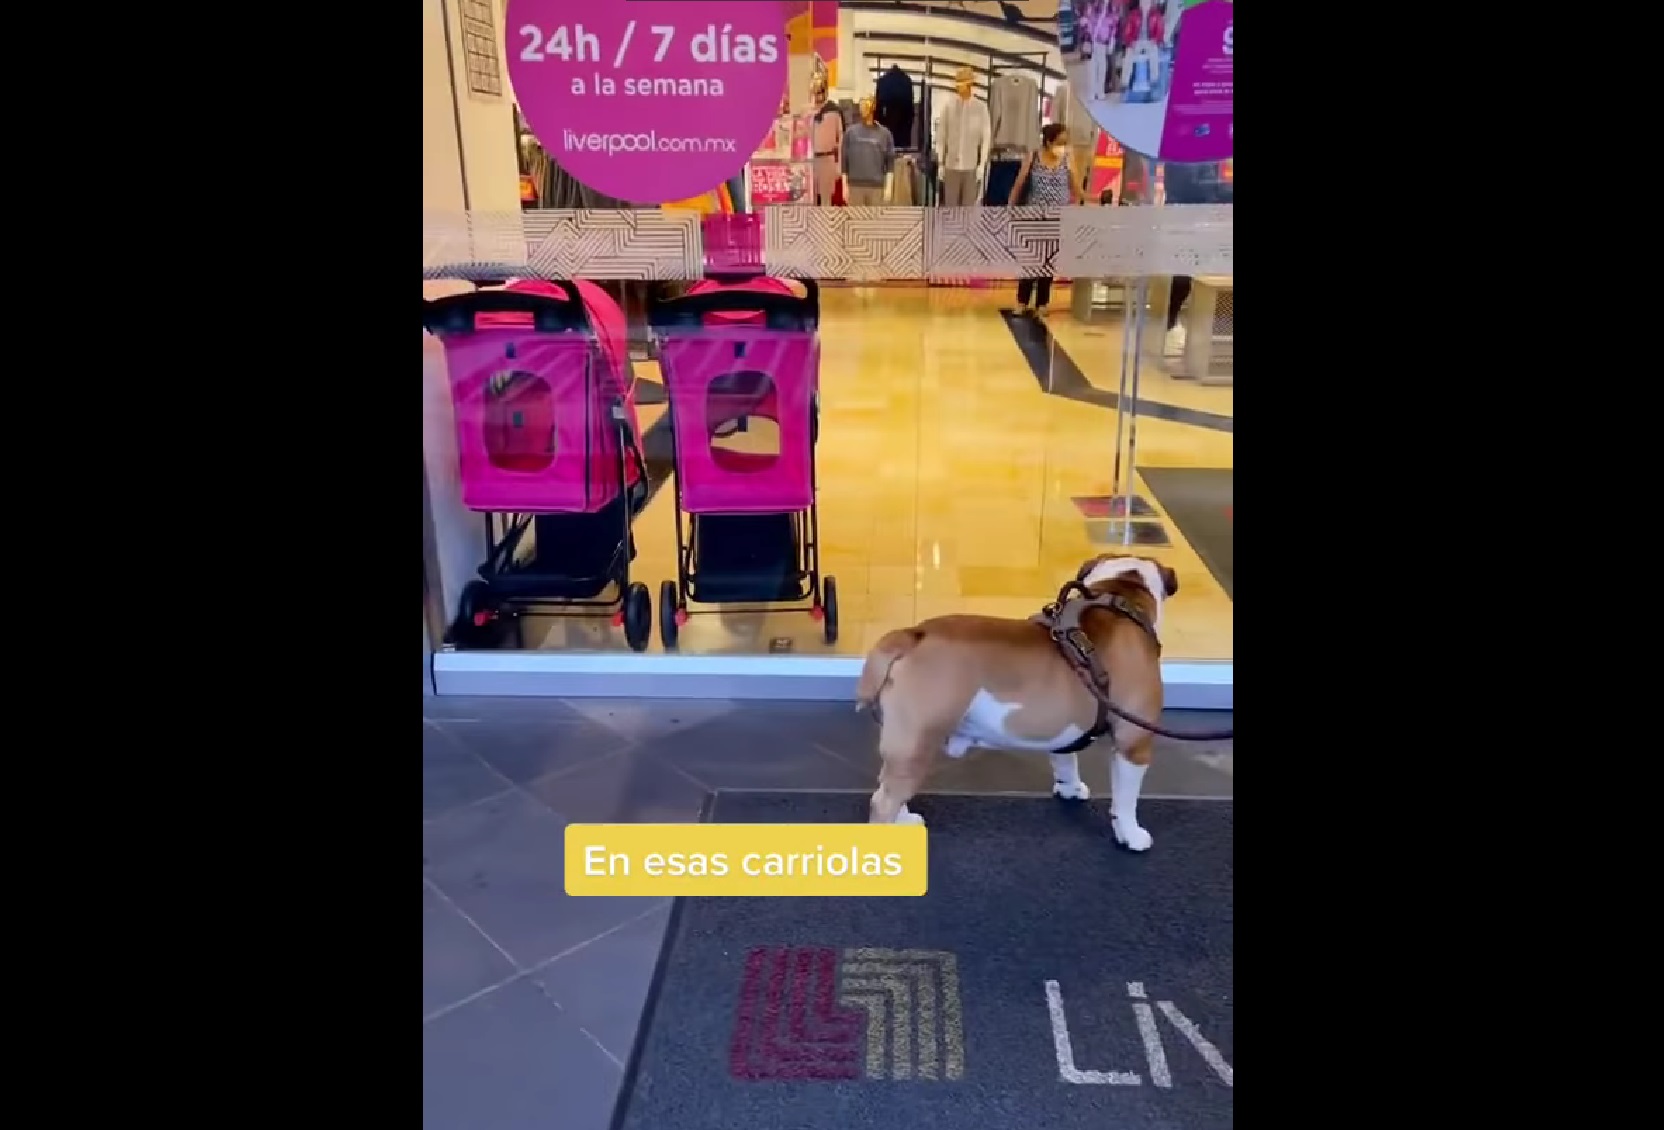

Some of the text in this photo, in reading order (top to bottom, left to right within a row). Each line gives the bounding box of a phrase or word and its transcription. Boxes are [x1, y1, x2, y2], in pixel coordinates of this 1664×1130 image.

[519, 20, 778, 68] 24h / 7 días
[571, 73, 725, 96] a la semana
[563, 129, 736, 155] liverpool.com.mx
